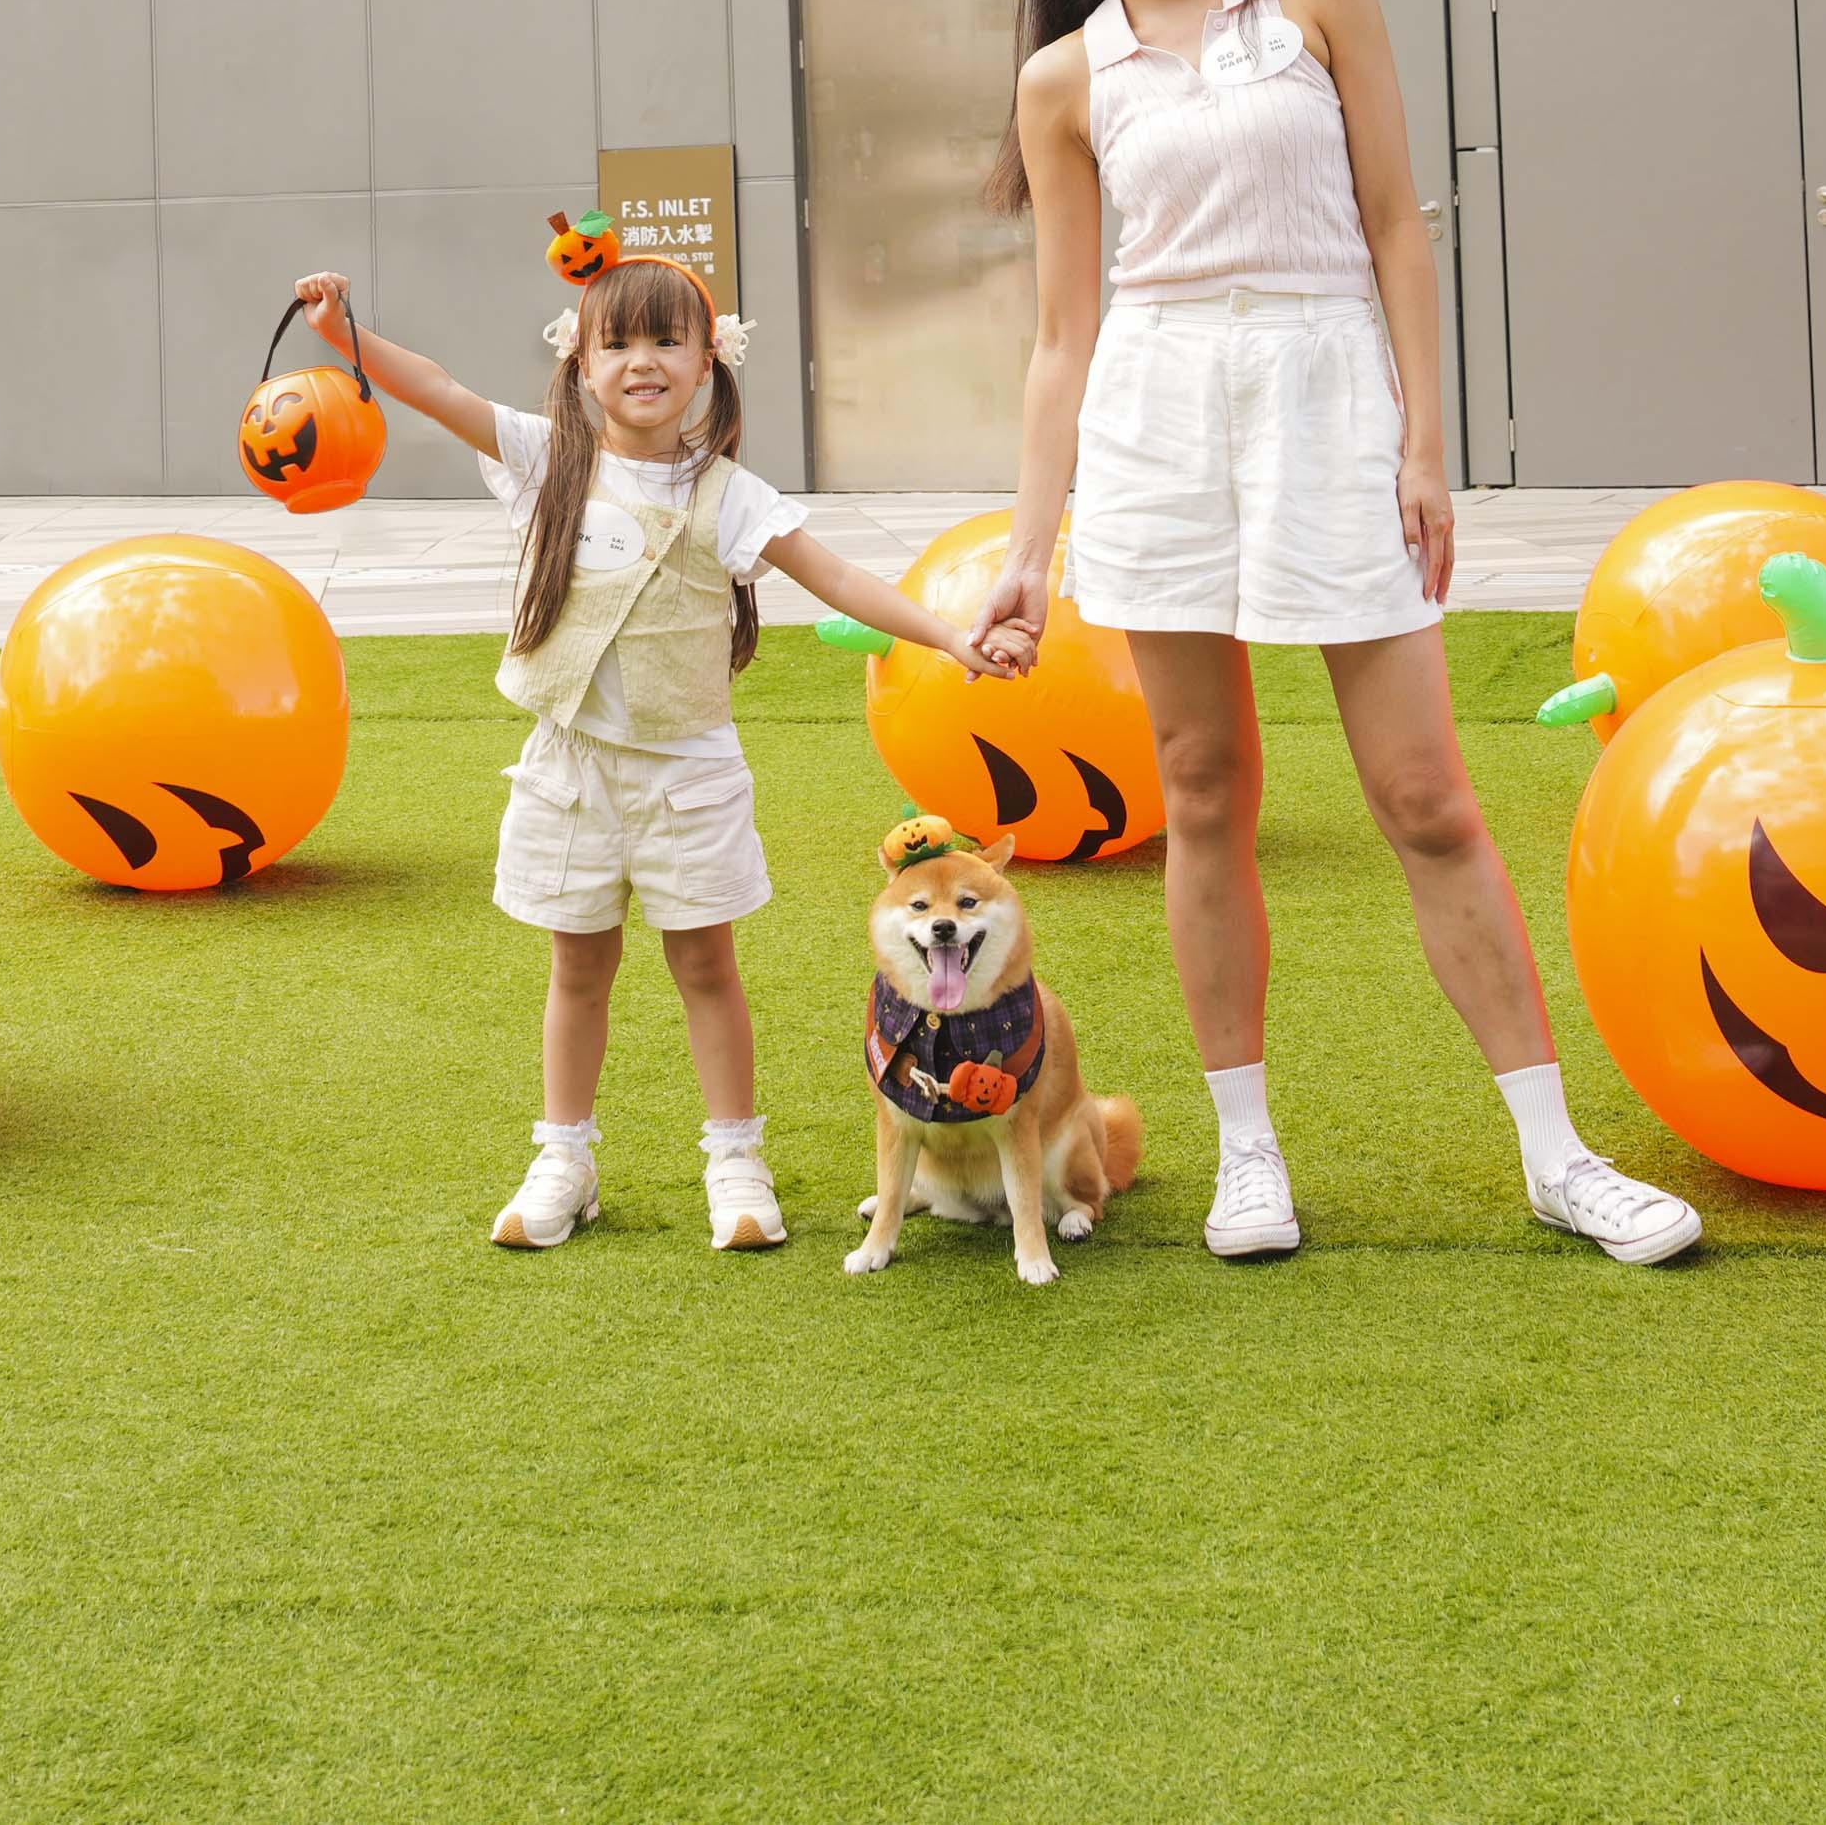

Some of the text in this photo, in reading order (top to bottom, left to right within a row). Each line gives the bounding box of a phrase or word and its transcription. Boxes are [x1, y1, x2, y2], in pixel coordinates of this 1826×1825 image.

[1216, 50, 1235, 64] GO
[1219, 52, 1253, 71] PARK
[621, 197, 712, 219] F.S. INLET
[578, 532, 592, 543] RK
